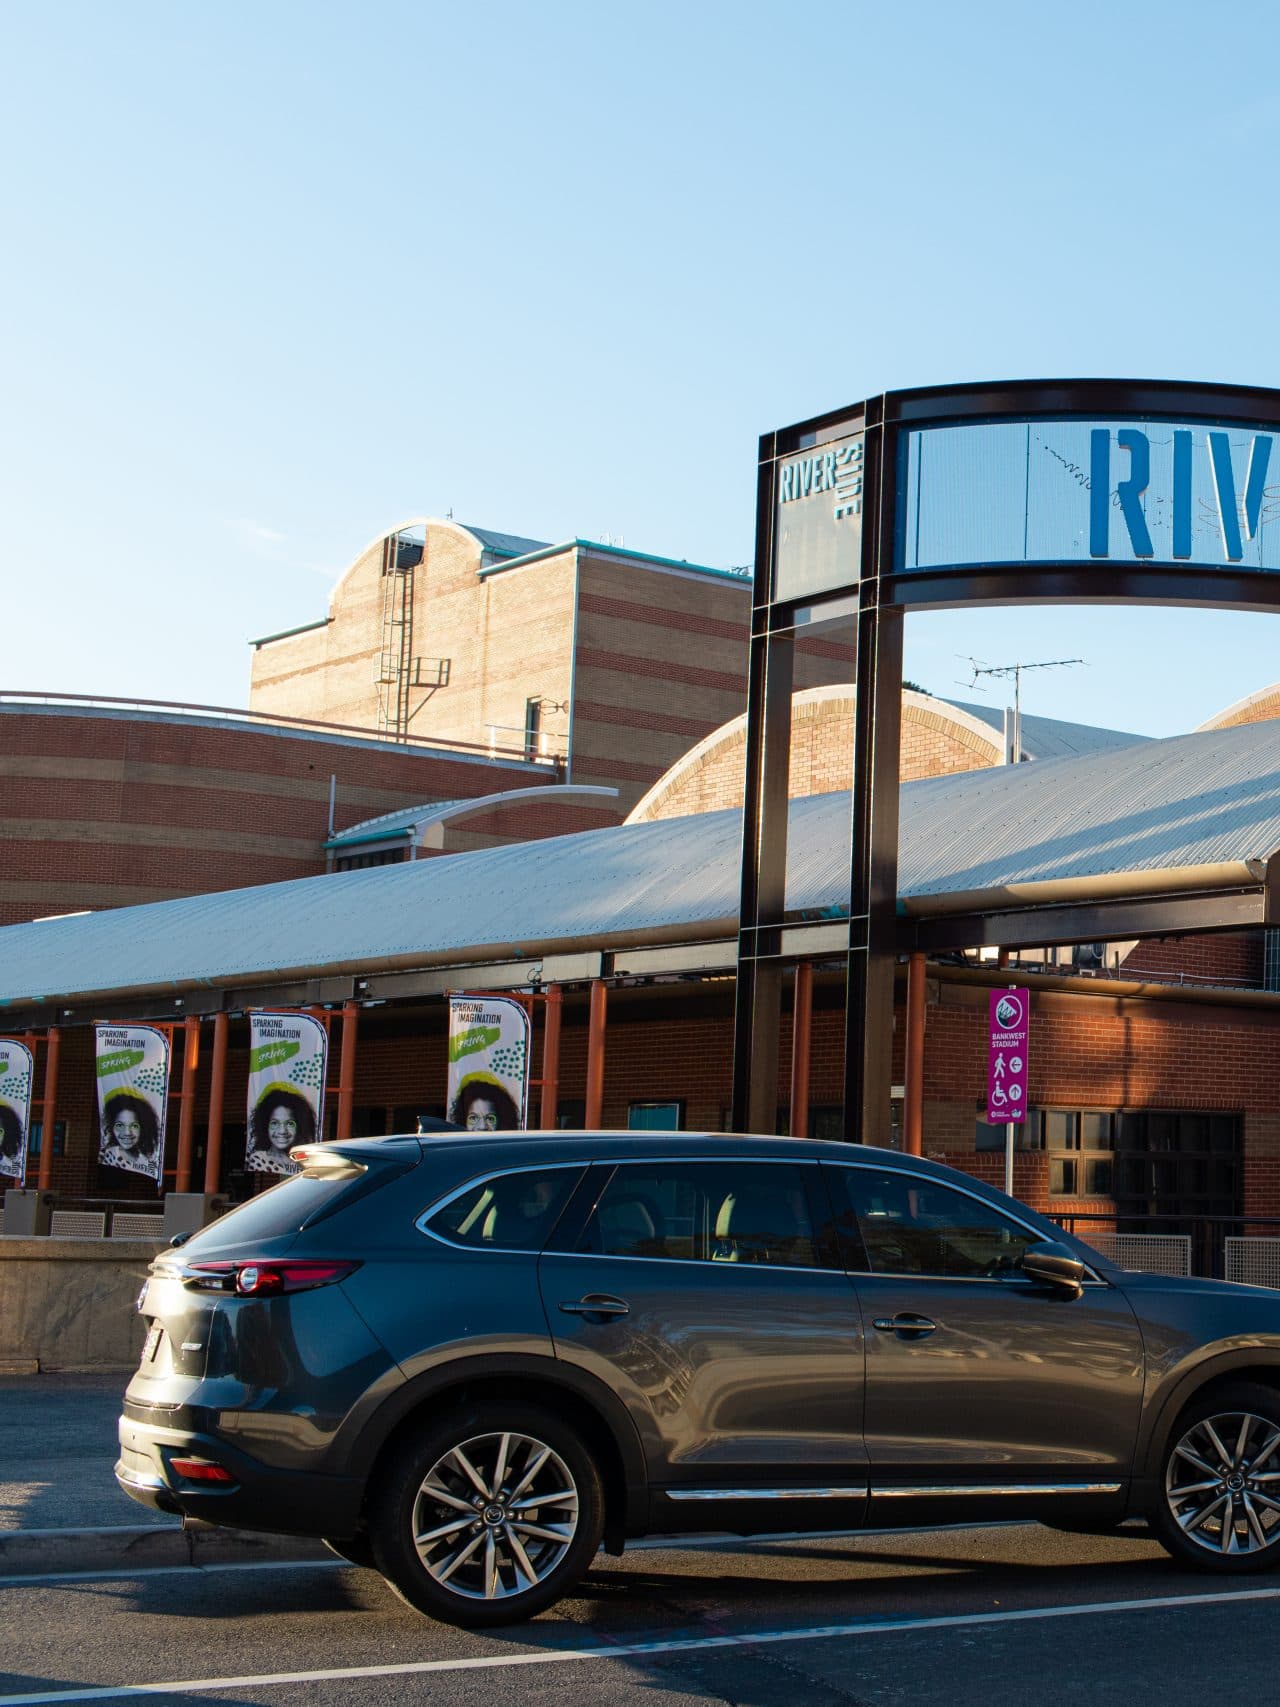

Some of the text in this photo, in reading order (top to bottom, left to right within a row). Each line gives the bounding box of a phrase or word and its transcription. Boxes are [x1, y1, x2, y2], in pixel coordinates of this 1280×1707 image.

[780, 451, 836, 503] RIVER
[834, 443, 863, 520] SIDE
[452, 1002, 483, 1012] SPARKING
[252, 1018, 283, 1028] SPARKING
[458, 1013, 502, 1024] IMAGINATION
[98, 1030, 128, 1038] SPARKING
[259, 1028, 301, 1039] IMAGINATION
[992, 1032, 1026, 1041] BANKWEST
[104, 1039, 145, 1048] IMAGINATION
[992, 1040, 1019, 1048] STADIUM
[257, 1048, 287, 1063] SPRING
[101, 1056, 131, 1069] SPRING
